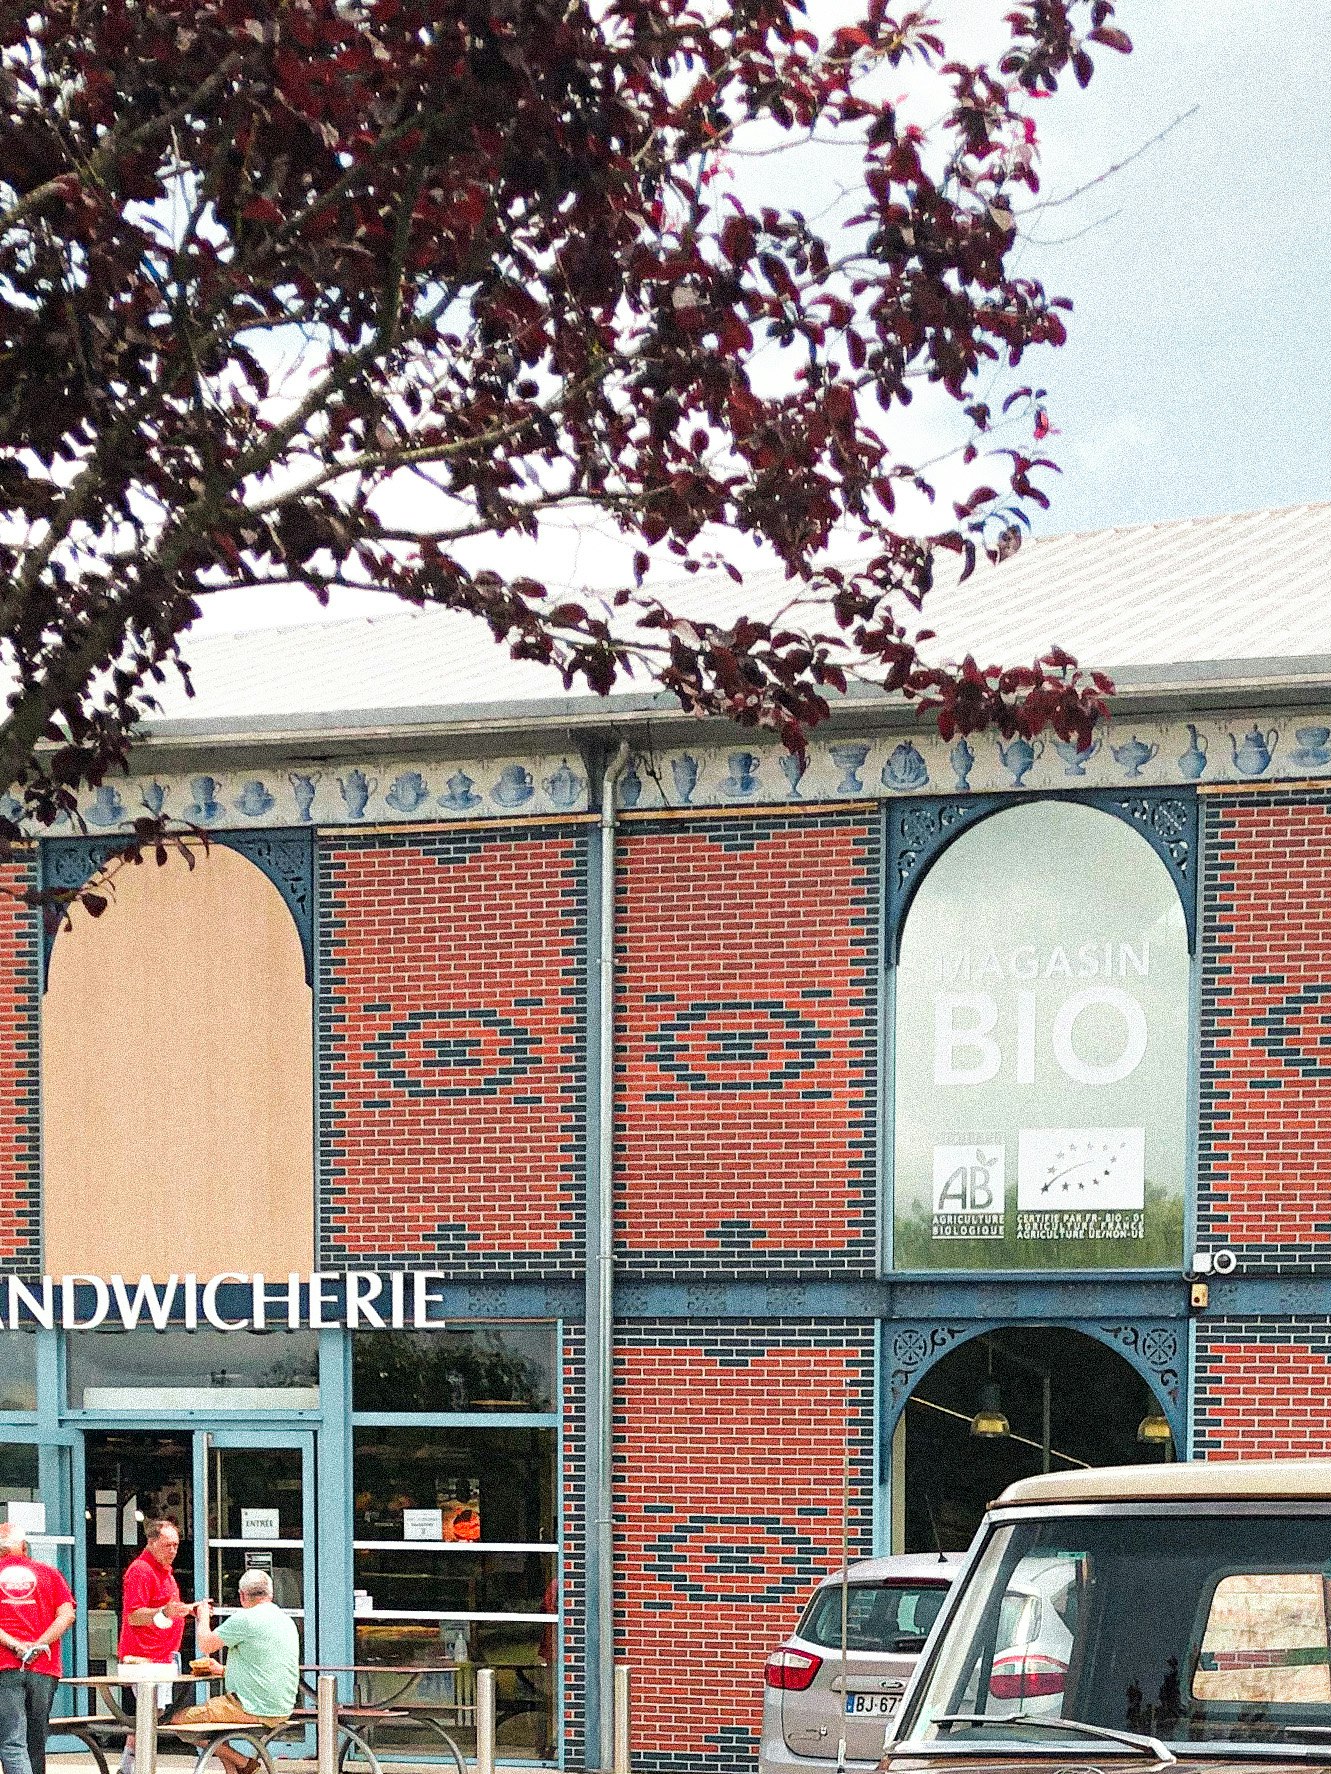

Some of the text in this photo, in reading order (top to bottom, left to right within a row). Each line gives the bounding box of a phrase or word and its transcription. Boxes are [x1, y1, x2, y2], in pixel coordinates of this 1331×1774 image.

[938, 943, 1150, 981] MAGASIN
[934, 985, 1149, 1086] BIO
[937, 1165, 994, 1211] AB
[932, 1214, 1005, 1225] AGRICULTURE
[932, 1225, 1005, 1236] BIOLOGIQUE
[1016, 1221, 1145, 1231] AGRICULTURE FRANCE
[1016, 1229, 1086, 1240] AGRICULTURE
